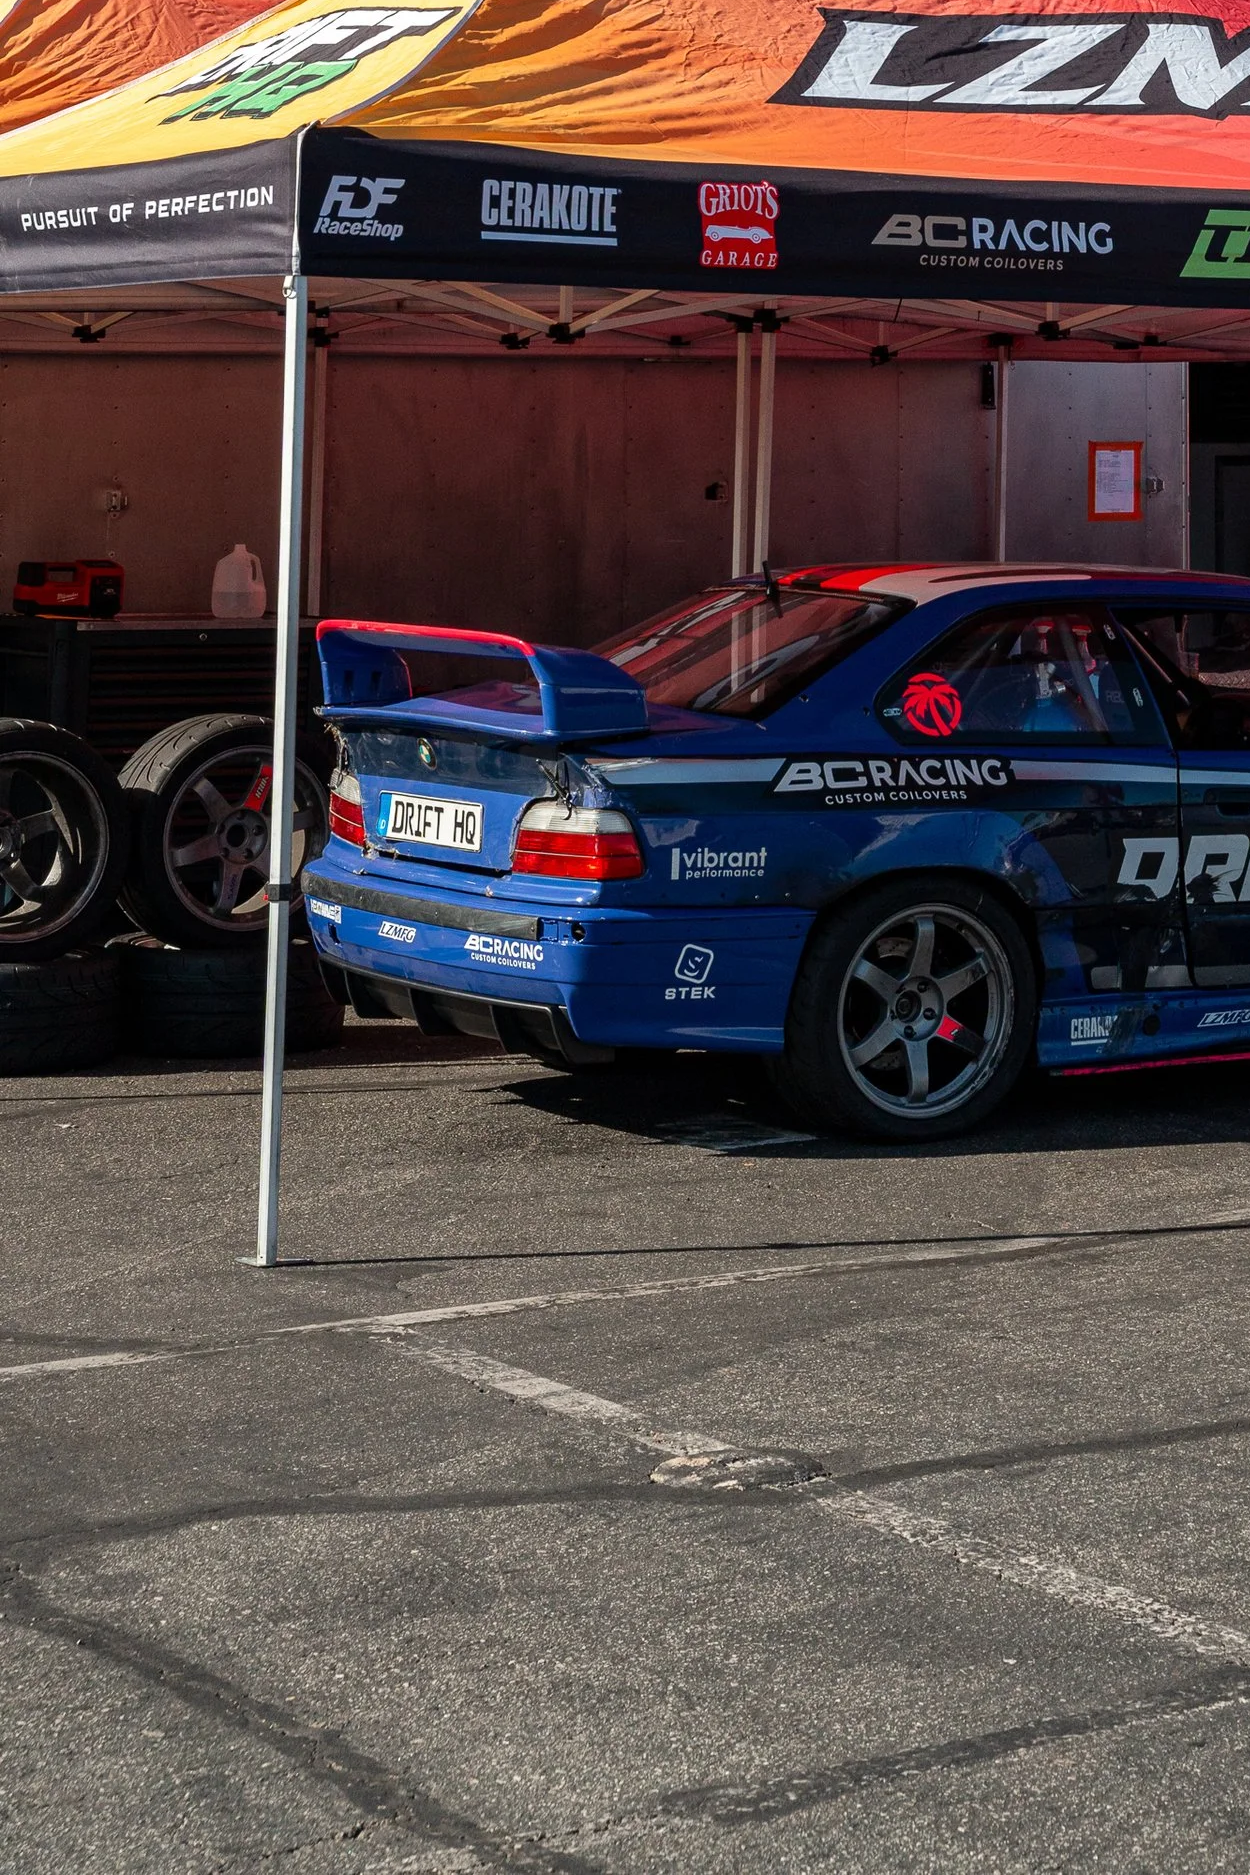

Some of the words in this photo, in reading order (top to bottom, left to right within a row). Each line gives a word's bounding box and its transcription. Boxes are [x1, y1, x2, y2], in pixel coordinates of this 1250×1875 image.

[21, 206, 100, 232] PURSUIT
[109, 202, 136, 224] OF
[144, 184, 276, 218] PERFECTION
[481, 179, 618, 232] CERAKOTE
[699, 180, 779, 220] GRIOT'S
[313, 216, 405, 242] RaceShop
[700, 250, 779, 270] GARAGE
[919, 254, 981, 270] CUSTOM
[983, 256, 1065, 272] COILOVERS
[824, 791, 886, 806] CUSTOM
[889, 790, 968, 803] COILOVERS
[392, 800, 444, 840] DRIFT
[453, 808, 477, 845] HQ
[683, 846, 768, 869] vibrant
[685, 866, 766, 880] performance
[380, 922, 416, 943] LZMFG
[470, 952, 496, 964] CUSTOM
[497, 957, 536, 970] COILOVERS
[664, 986, 716, 1000] STEK
